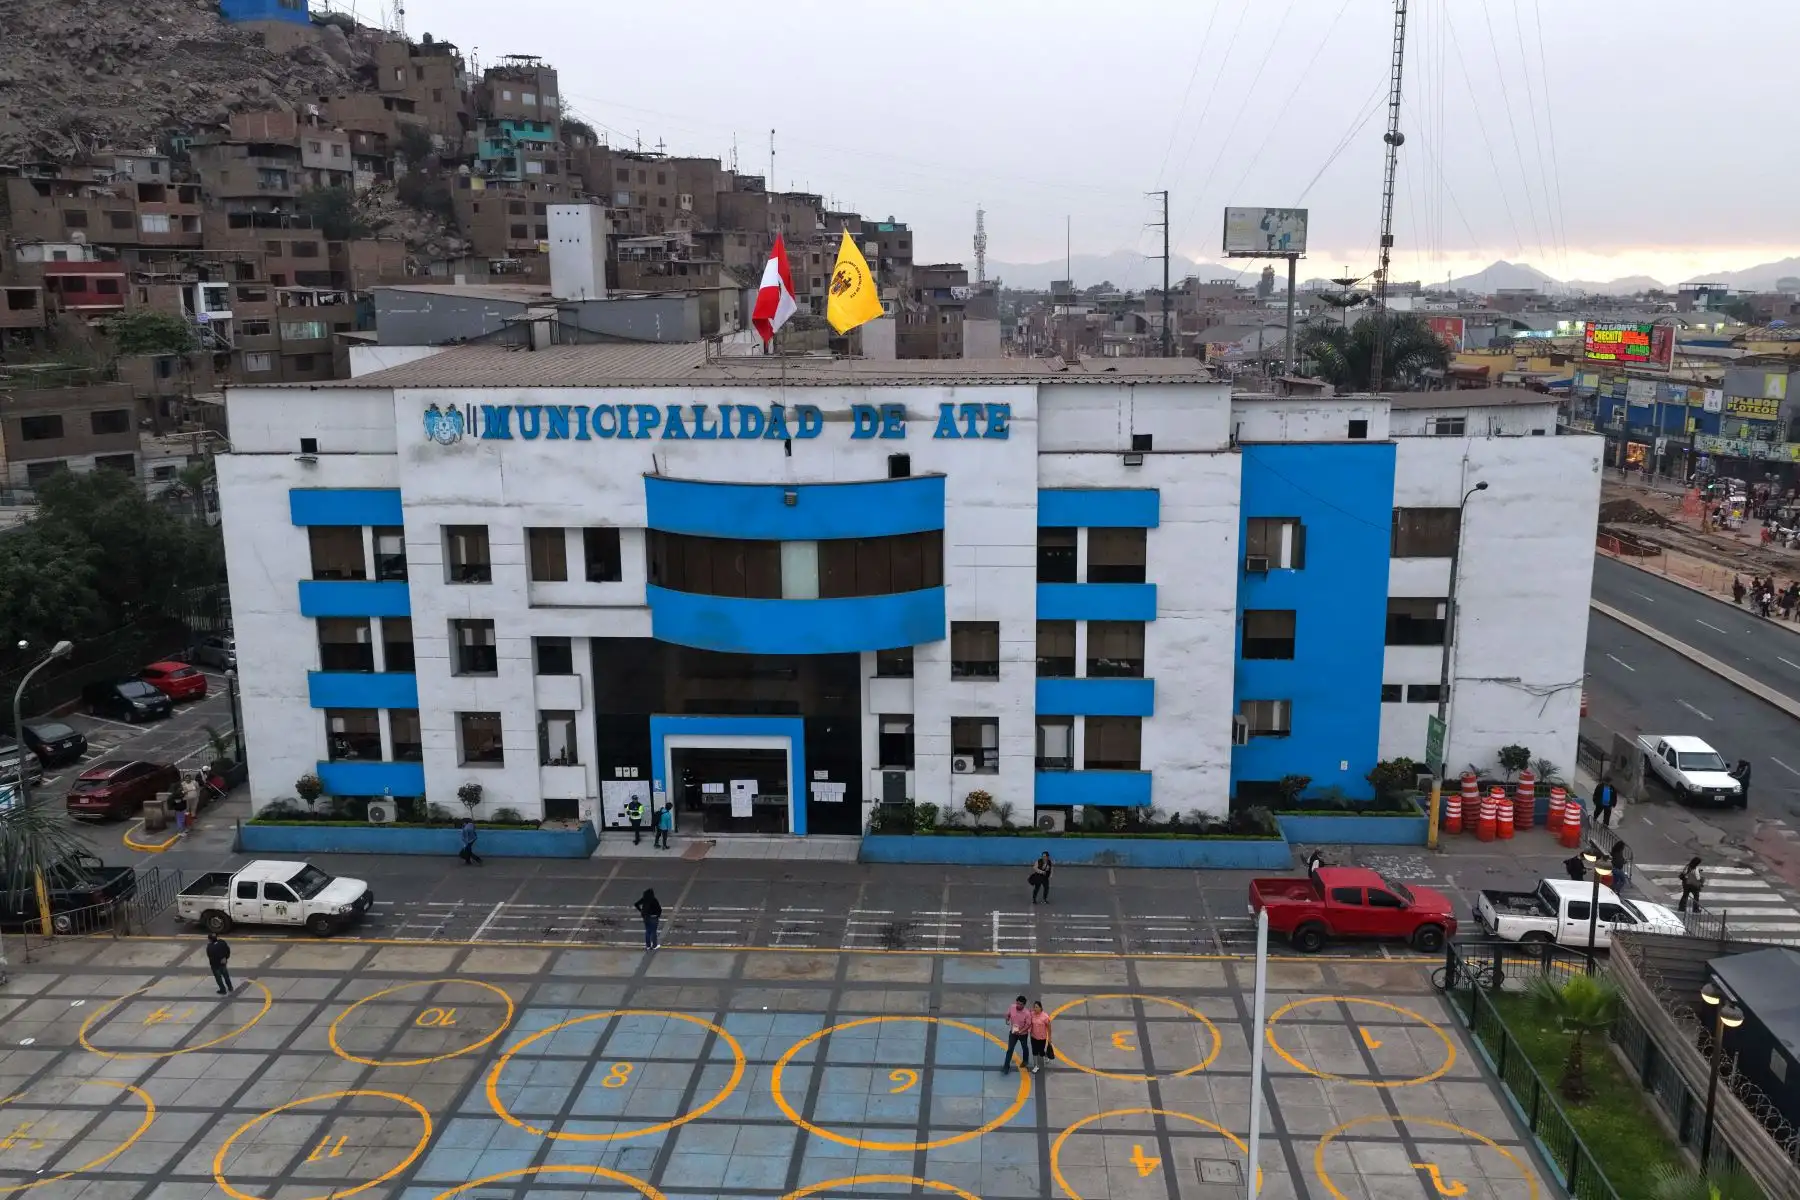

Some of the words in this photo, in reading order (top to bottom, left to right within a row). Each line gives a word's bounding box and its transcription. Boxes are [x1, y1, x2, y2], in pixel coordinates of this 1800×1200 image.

[480, 404, 824, 441] MUNICIPALIDAD
[850, 404, 907, 440] DE
[933, 402, 1011, 440] ATE
[1728, 403, 1777, 415] PLOTEOS
[416, 1007, 457, 1027] 10
[1110, 1029, 1137, 1052] 3
[1359, 1026, 1384, 1050] 1
[602, 1061, 634, 1089] 8
[1128, 1143, 1162, 1178] 4
[1410, 1161, 1470, 1198] 2
